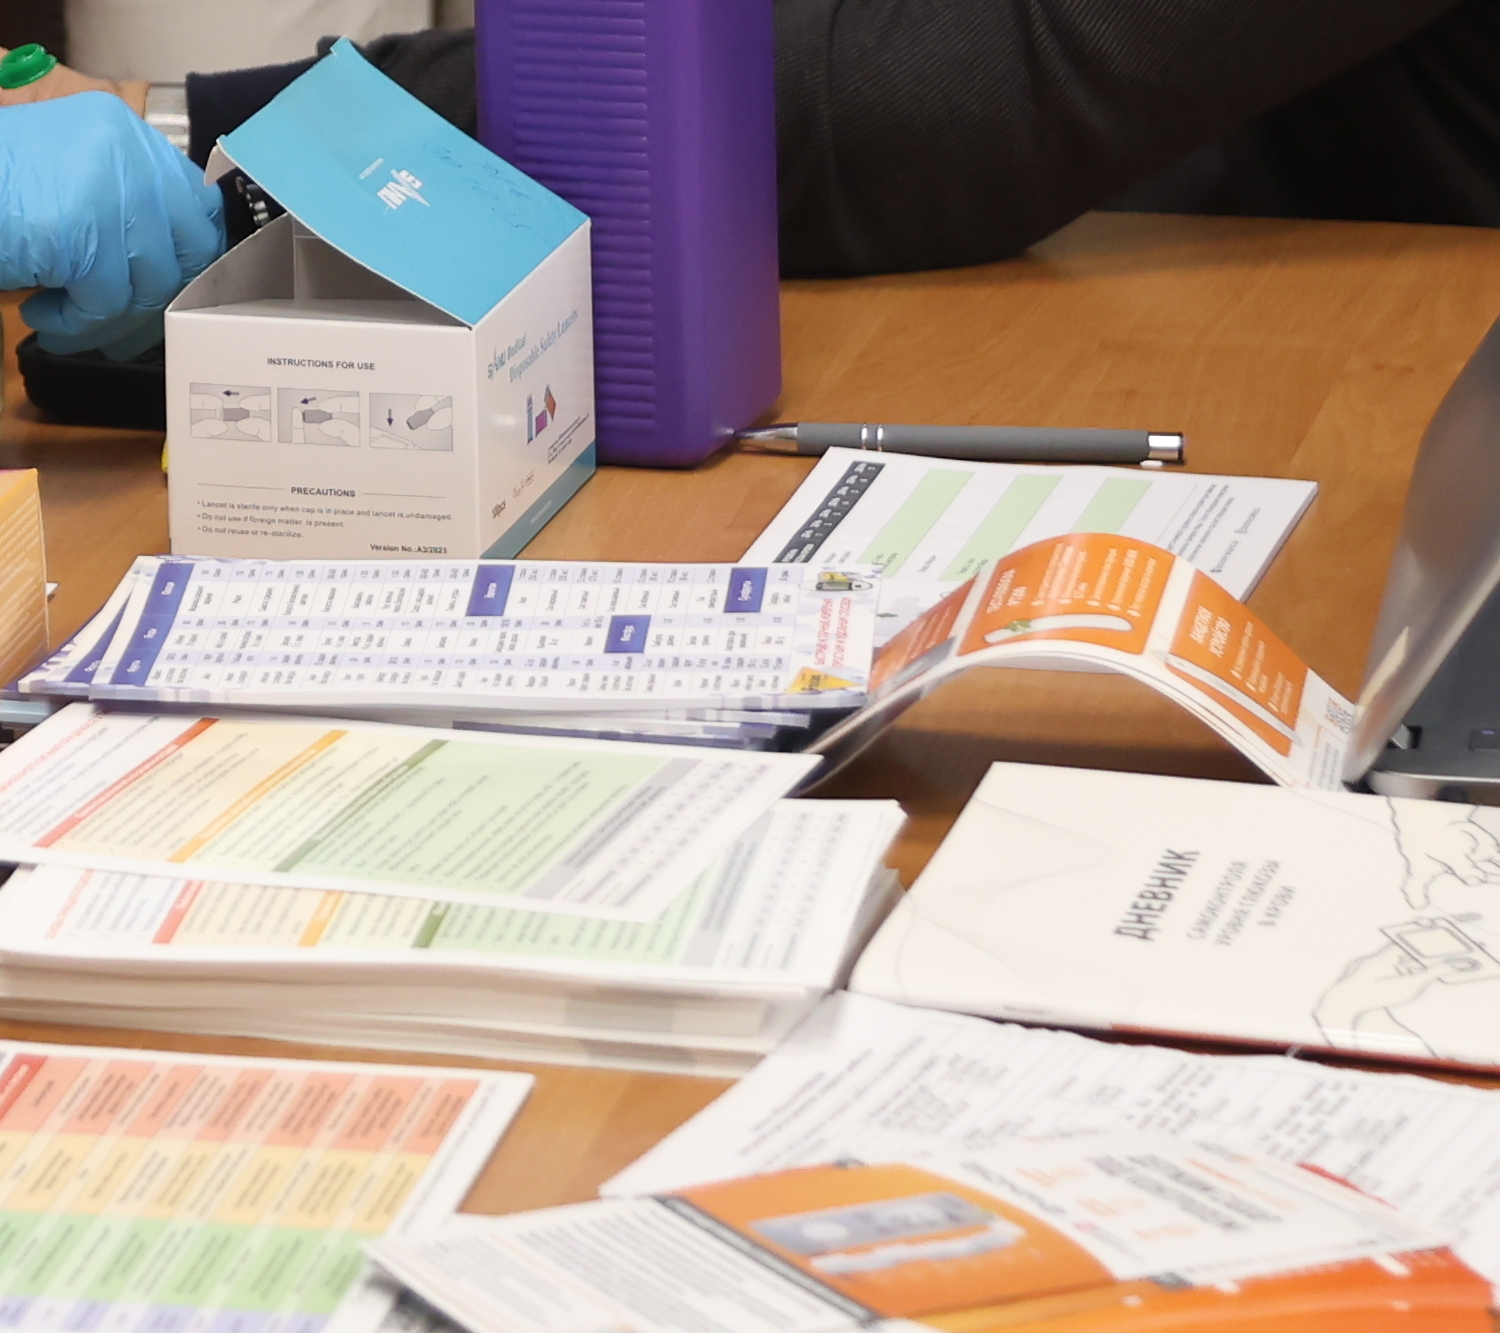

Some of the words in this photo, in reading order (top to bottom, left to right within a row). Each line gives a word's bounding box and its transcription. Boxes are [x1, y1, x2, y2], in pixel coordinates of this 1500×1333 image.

[267, 357, 334, 369] INSTRUCTIONS
[336, 361, 354, 369] FOR
[357, 362, 376, 371] USE
[290, 486, 356, 497] PRECAUTIONS
[370, 543, 400, 552] Version
[1113, 848, 1200, 941] ДНЕВНИК
